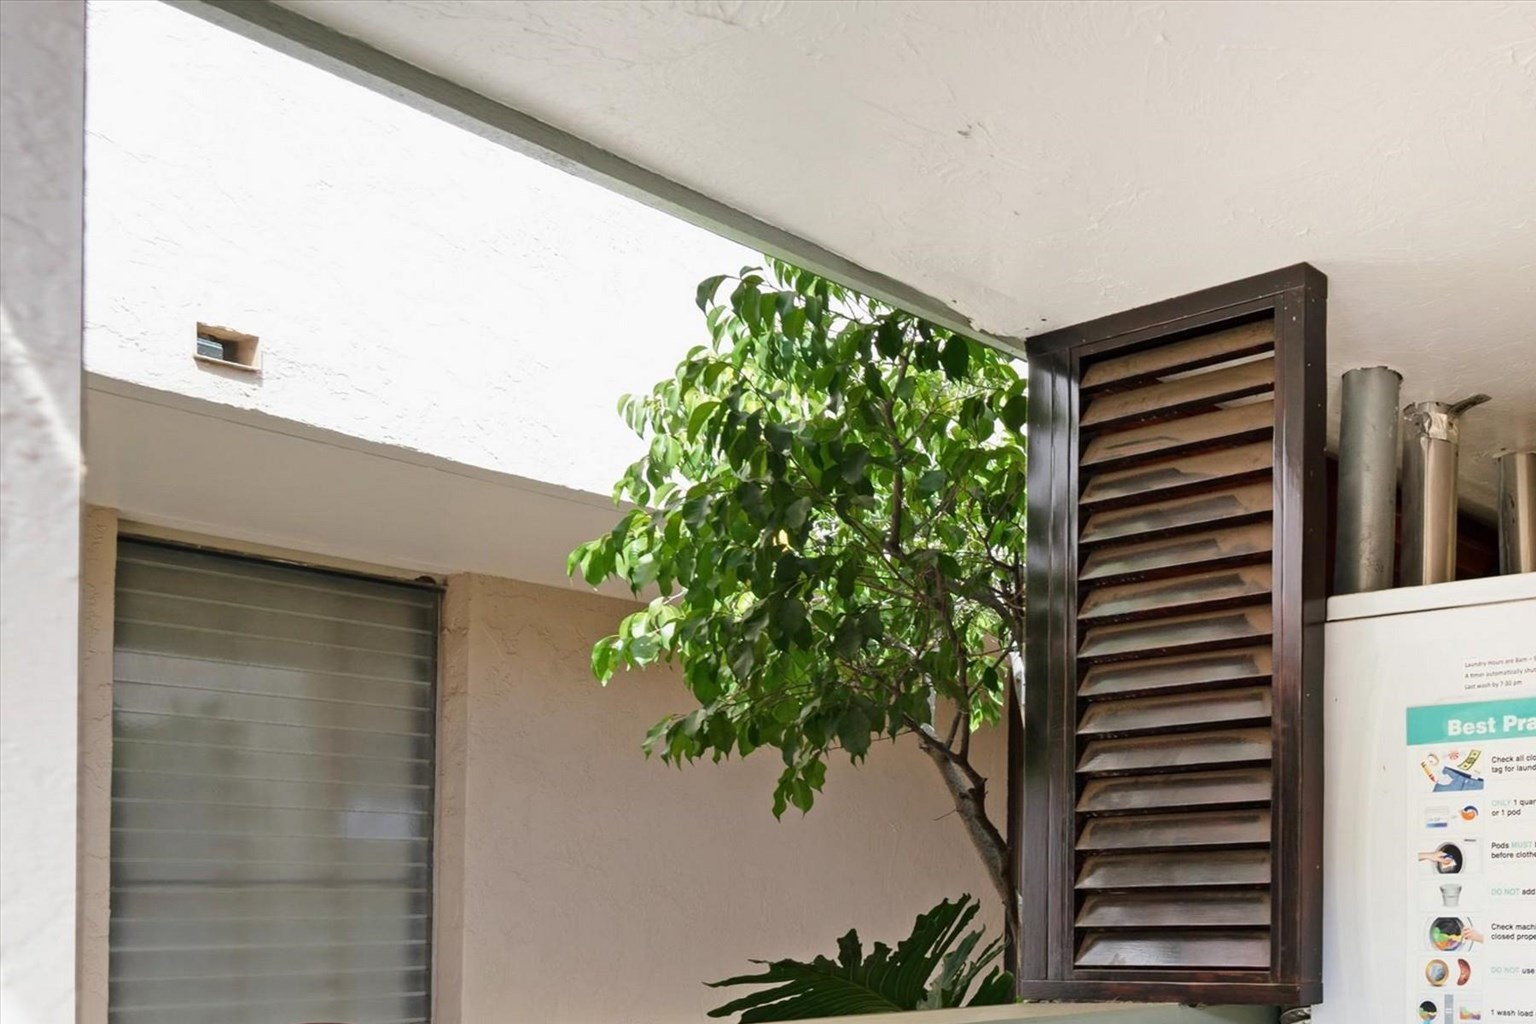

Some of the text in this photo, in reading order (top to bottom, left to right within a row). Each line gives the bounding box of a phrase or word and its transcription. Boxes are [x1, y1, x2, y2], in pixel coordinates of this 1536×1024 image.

[1447, 717, 1496, 736] Best
[1492, 755, 1513, 764] Check
[1516, 754, 1524, 762] all
[1492, 766, 1503, 774] tag
